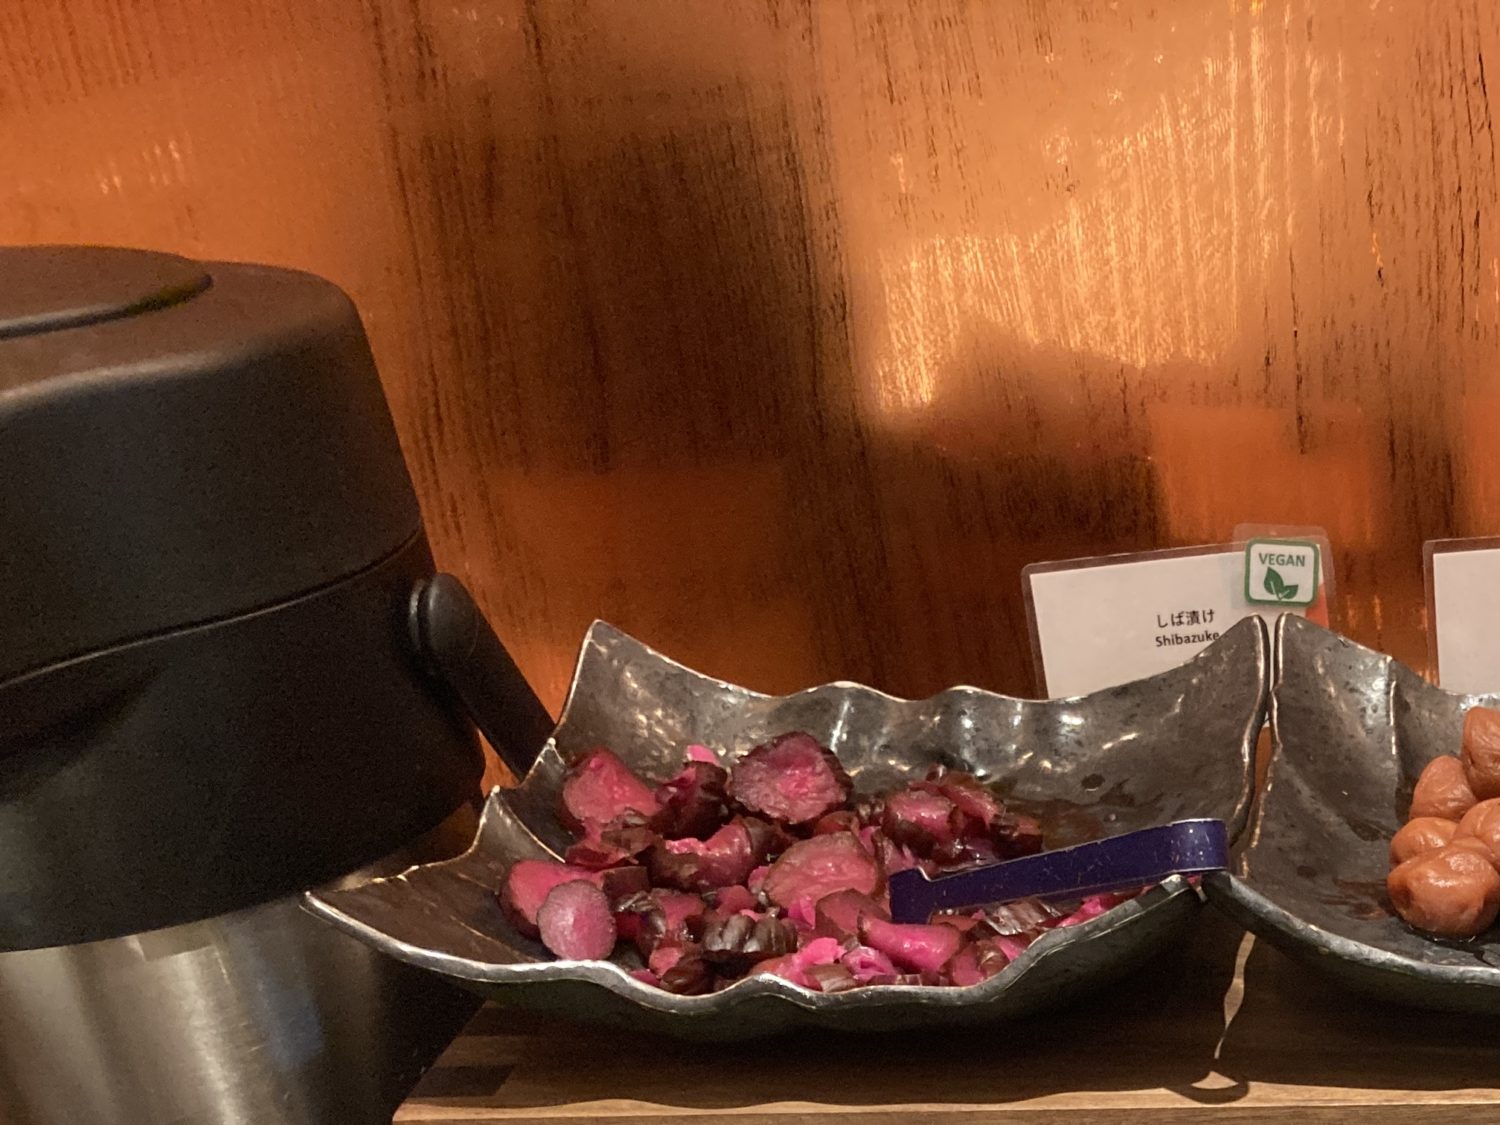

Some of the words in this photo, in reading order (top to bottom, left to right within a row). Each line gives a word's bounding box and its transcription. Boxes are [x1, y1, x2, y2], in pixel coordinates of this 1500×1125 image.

[1258, 552, 1306, 567] VEGAN
[1157, 608, 1215, 629] しば漬け
[1155, 630, 1220, 647] Shibazuke
